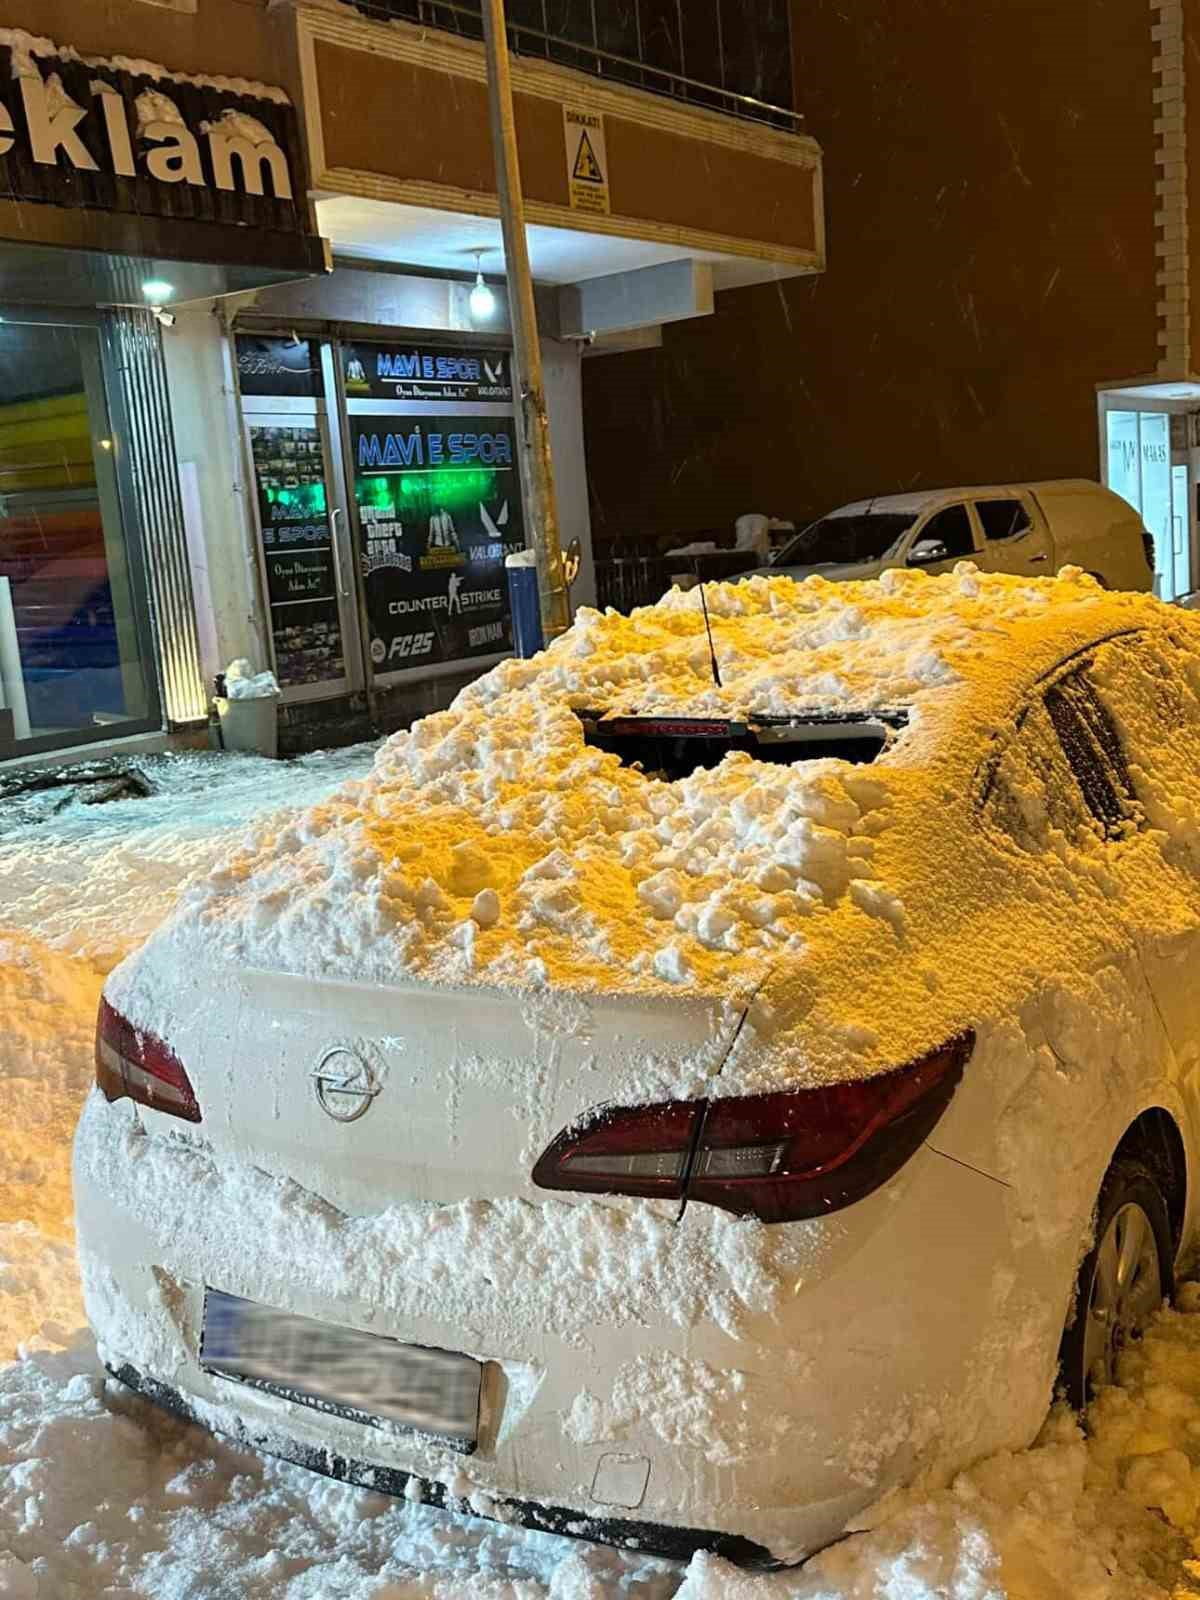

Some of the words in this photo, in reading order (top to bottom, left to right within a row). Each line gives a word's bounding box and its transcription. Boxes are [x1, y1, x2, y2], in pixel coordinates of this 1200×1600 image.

[377, 350, 421, 378] MAVİ
[423, 356, 433, 378] E
[436, 356, 481, 380] SPOR
[359, 425, 424, 466] MAVİ
[427, 434, 445, 464] E
[448, 434, 512, 464] SPOR
[388, 595, 448, 615] COUNTER
[460, 588, 502, 606] STRIKE
